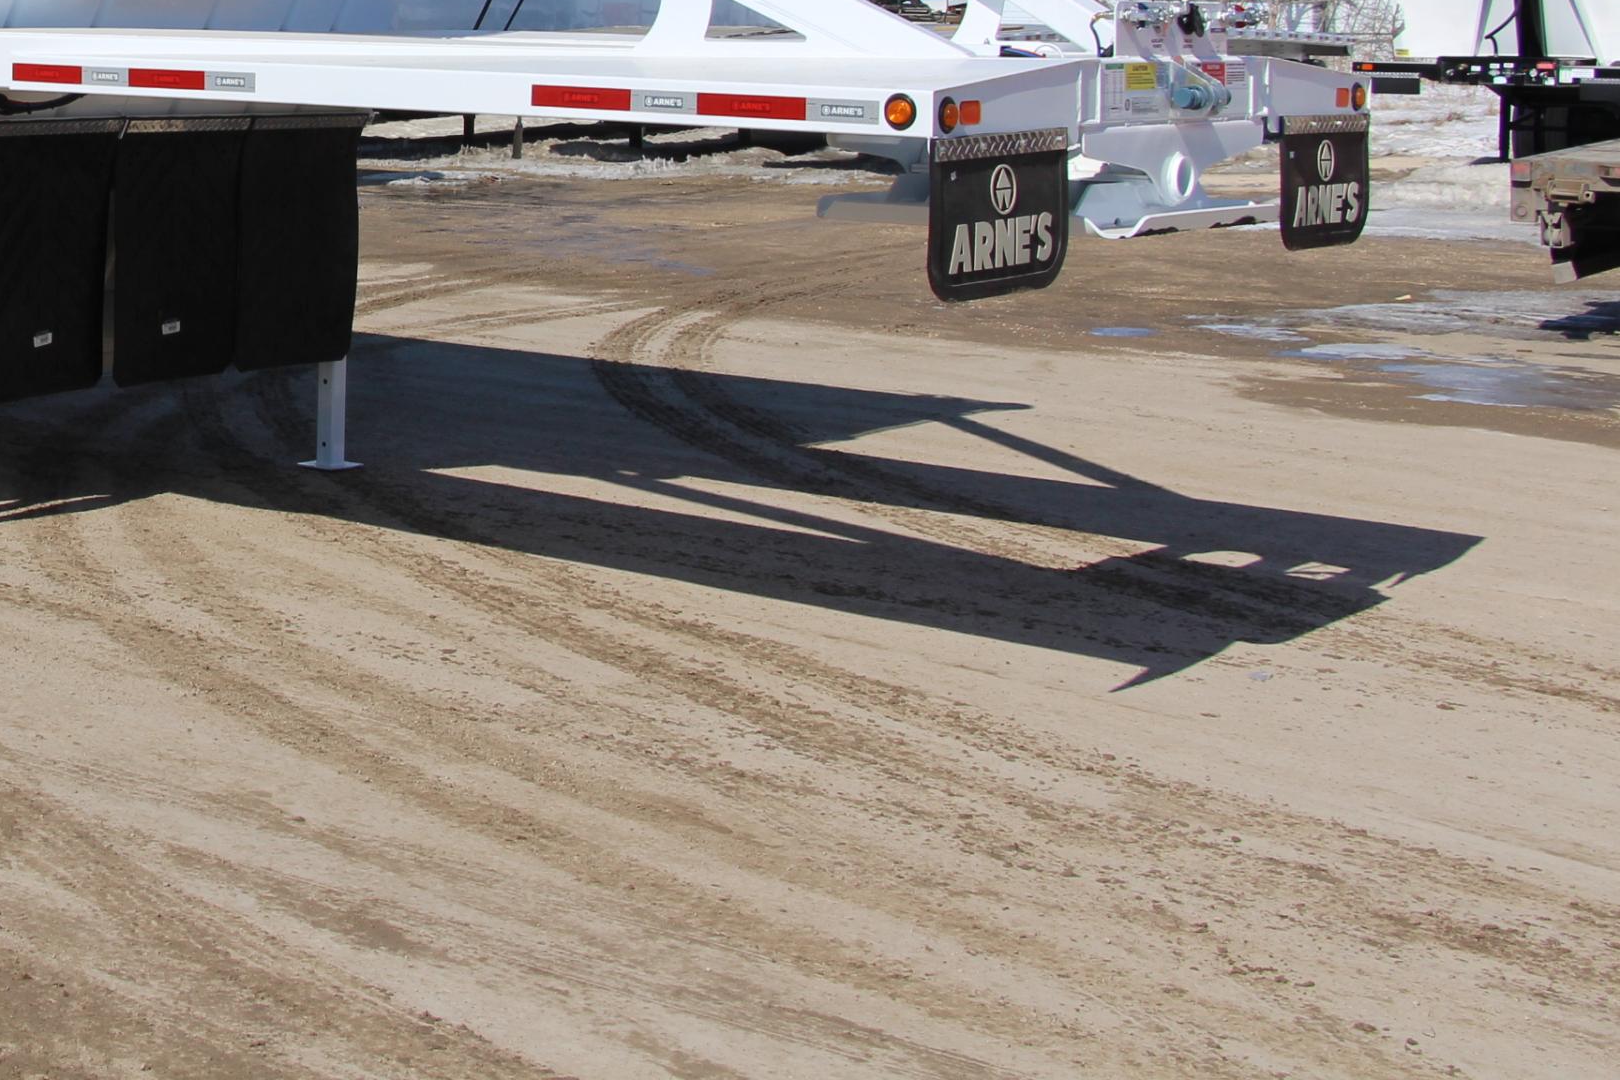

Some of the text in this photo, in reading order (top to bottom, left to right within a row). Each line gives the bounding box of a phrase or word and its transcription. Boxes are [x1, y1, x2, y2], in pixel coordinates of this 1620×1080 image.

[222, 77, 245, 87] ARNE'S
[653, 96, 683, 107] ARNE'S
[831, 105, 863, 116] ARNE'S
[1293, 181, 1360, 228] ARNE'S
[948, 211, 1053, 275] ARNE'S
